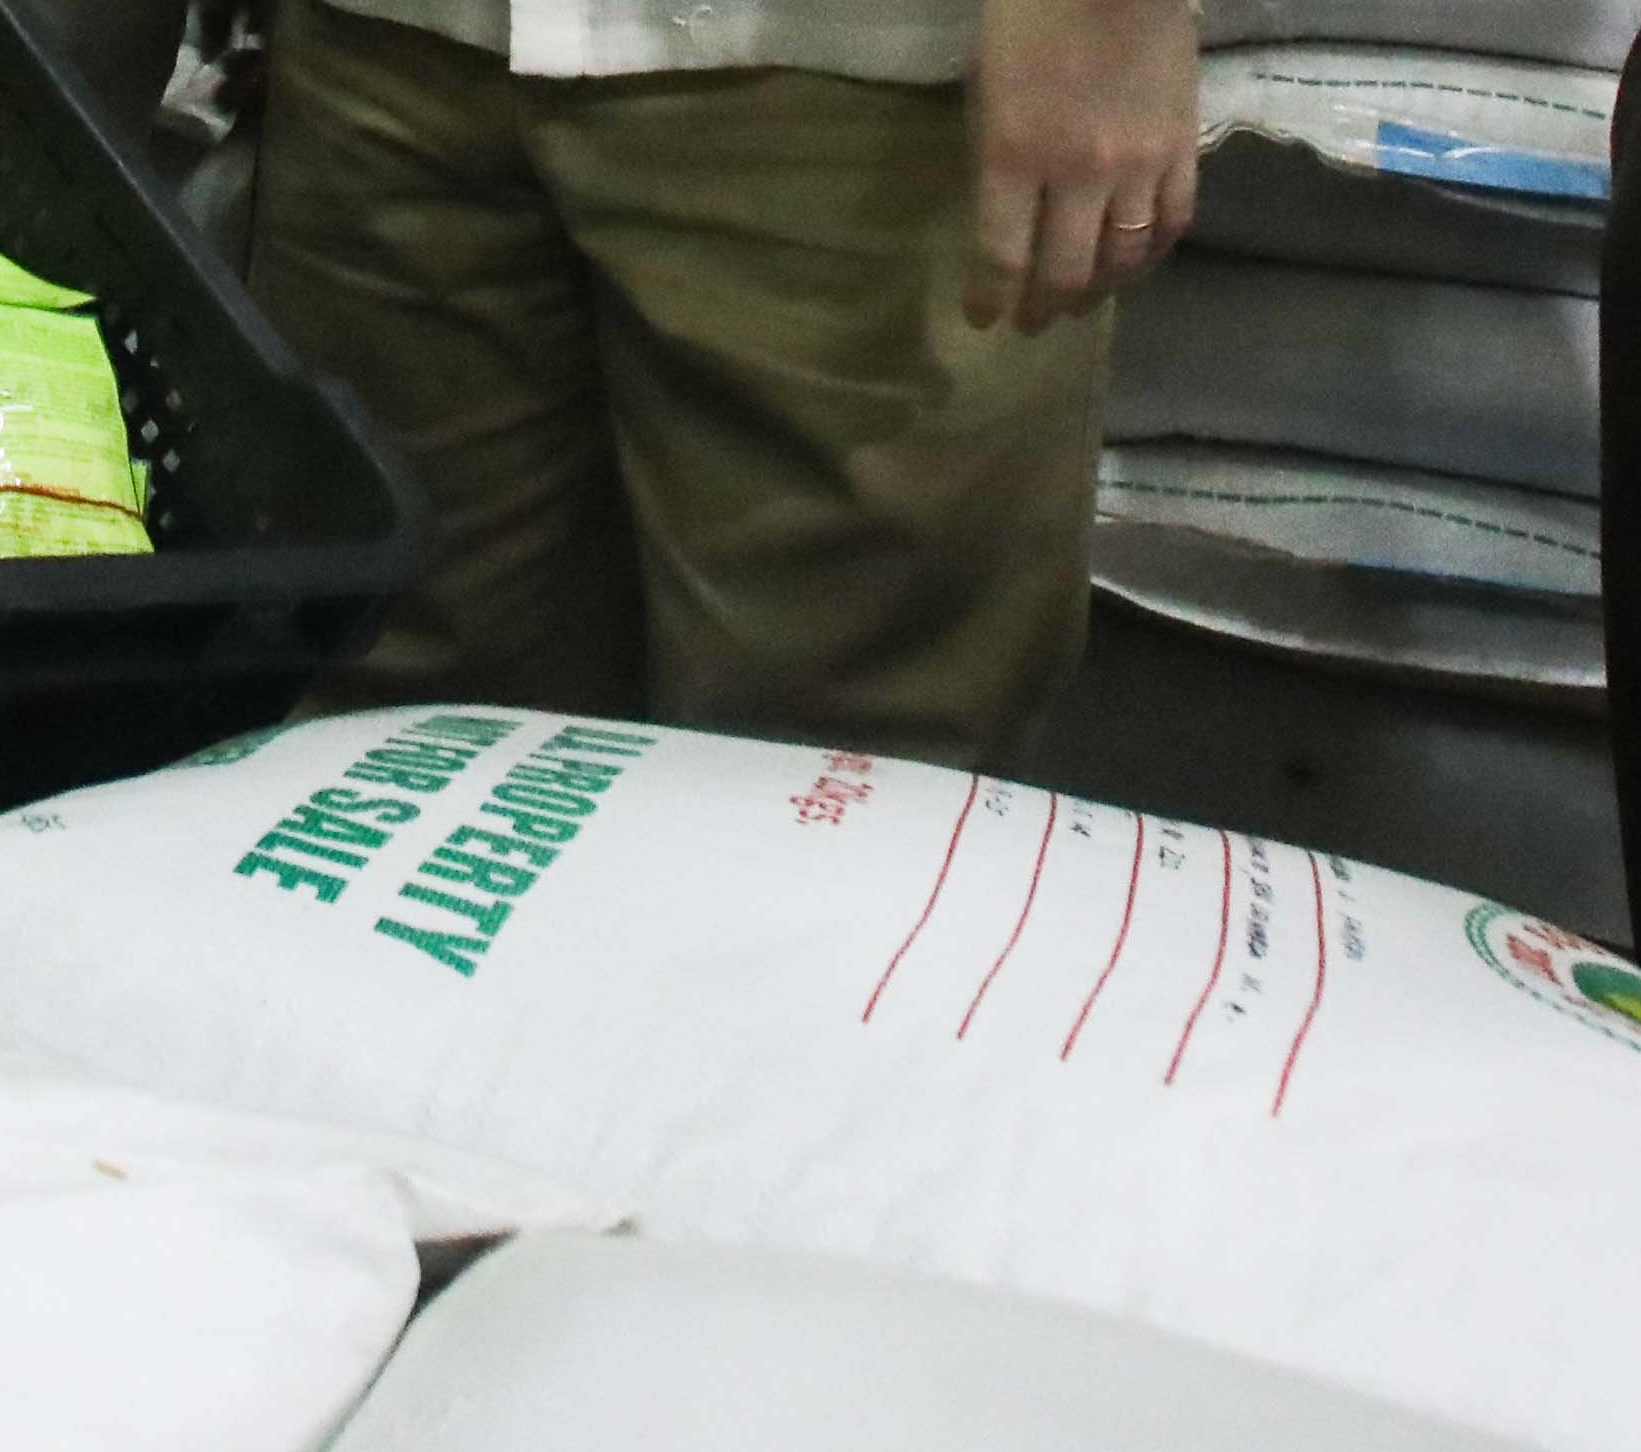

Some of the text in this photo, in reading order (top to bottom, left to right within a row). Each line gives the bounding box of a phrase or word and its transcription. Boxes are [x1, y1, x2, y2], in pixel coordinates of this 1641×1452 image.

[341, 736, 480, 795] FOR
[231, 786, 423, 906] SALE
[372, 751, 626, 979] PROPERTY
